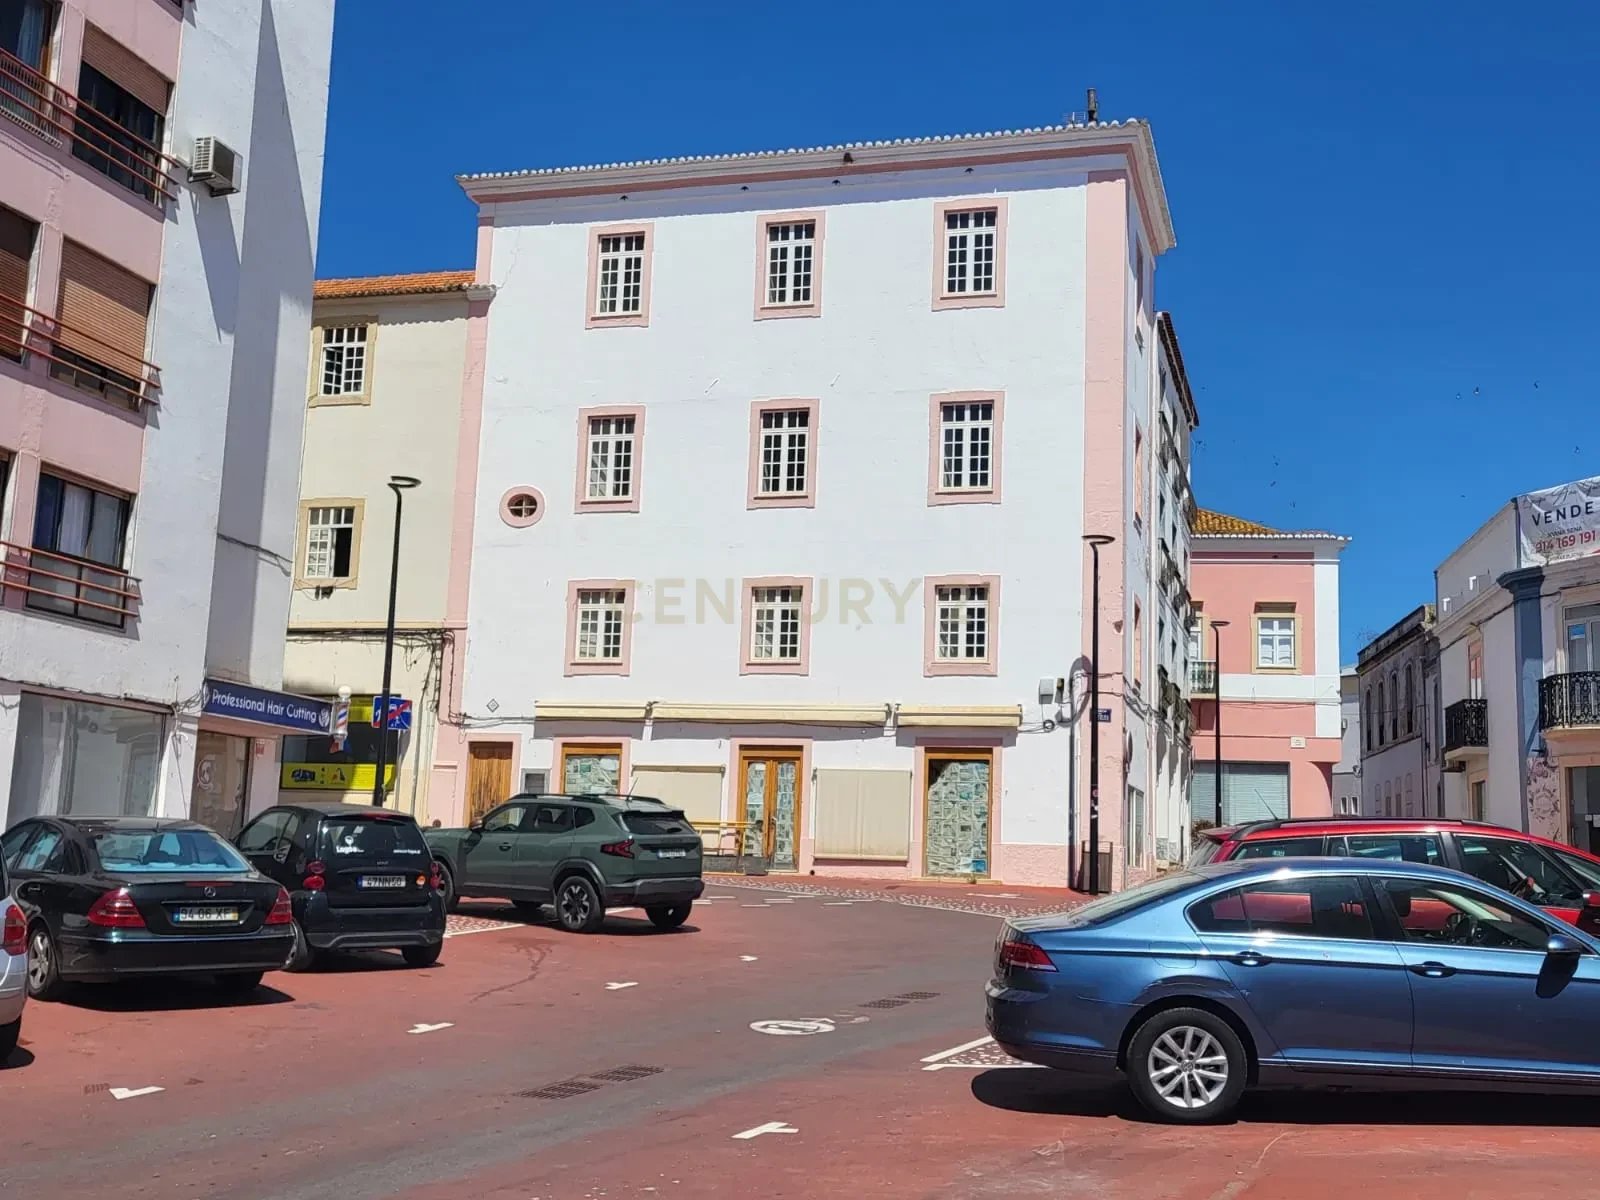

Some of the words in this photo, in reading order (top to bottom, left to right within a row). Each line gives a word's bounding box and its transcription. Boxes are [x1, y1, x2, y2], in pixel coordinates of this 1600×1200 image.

[1532, 501, 1594, 526] VENDE
[1556, 534, 1576, 549] 169
[1579, 530, 1596, 544] 191
[211, 688, 265, 713] Professional
[267, 699, 285, 716] Hair
[286, 703, 317, 724] Cutting
